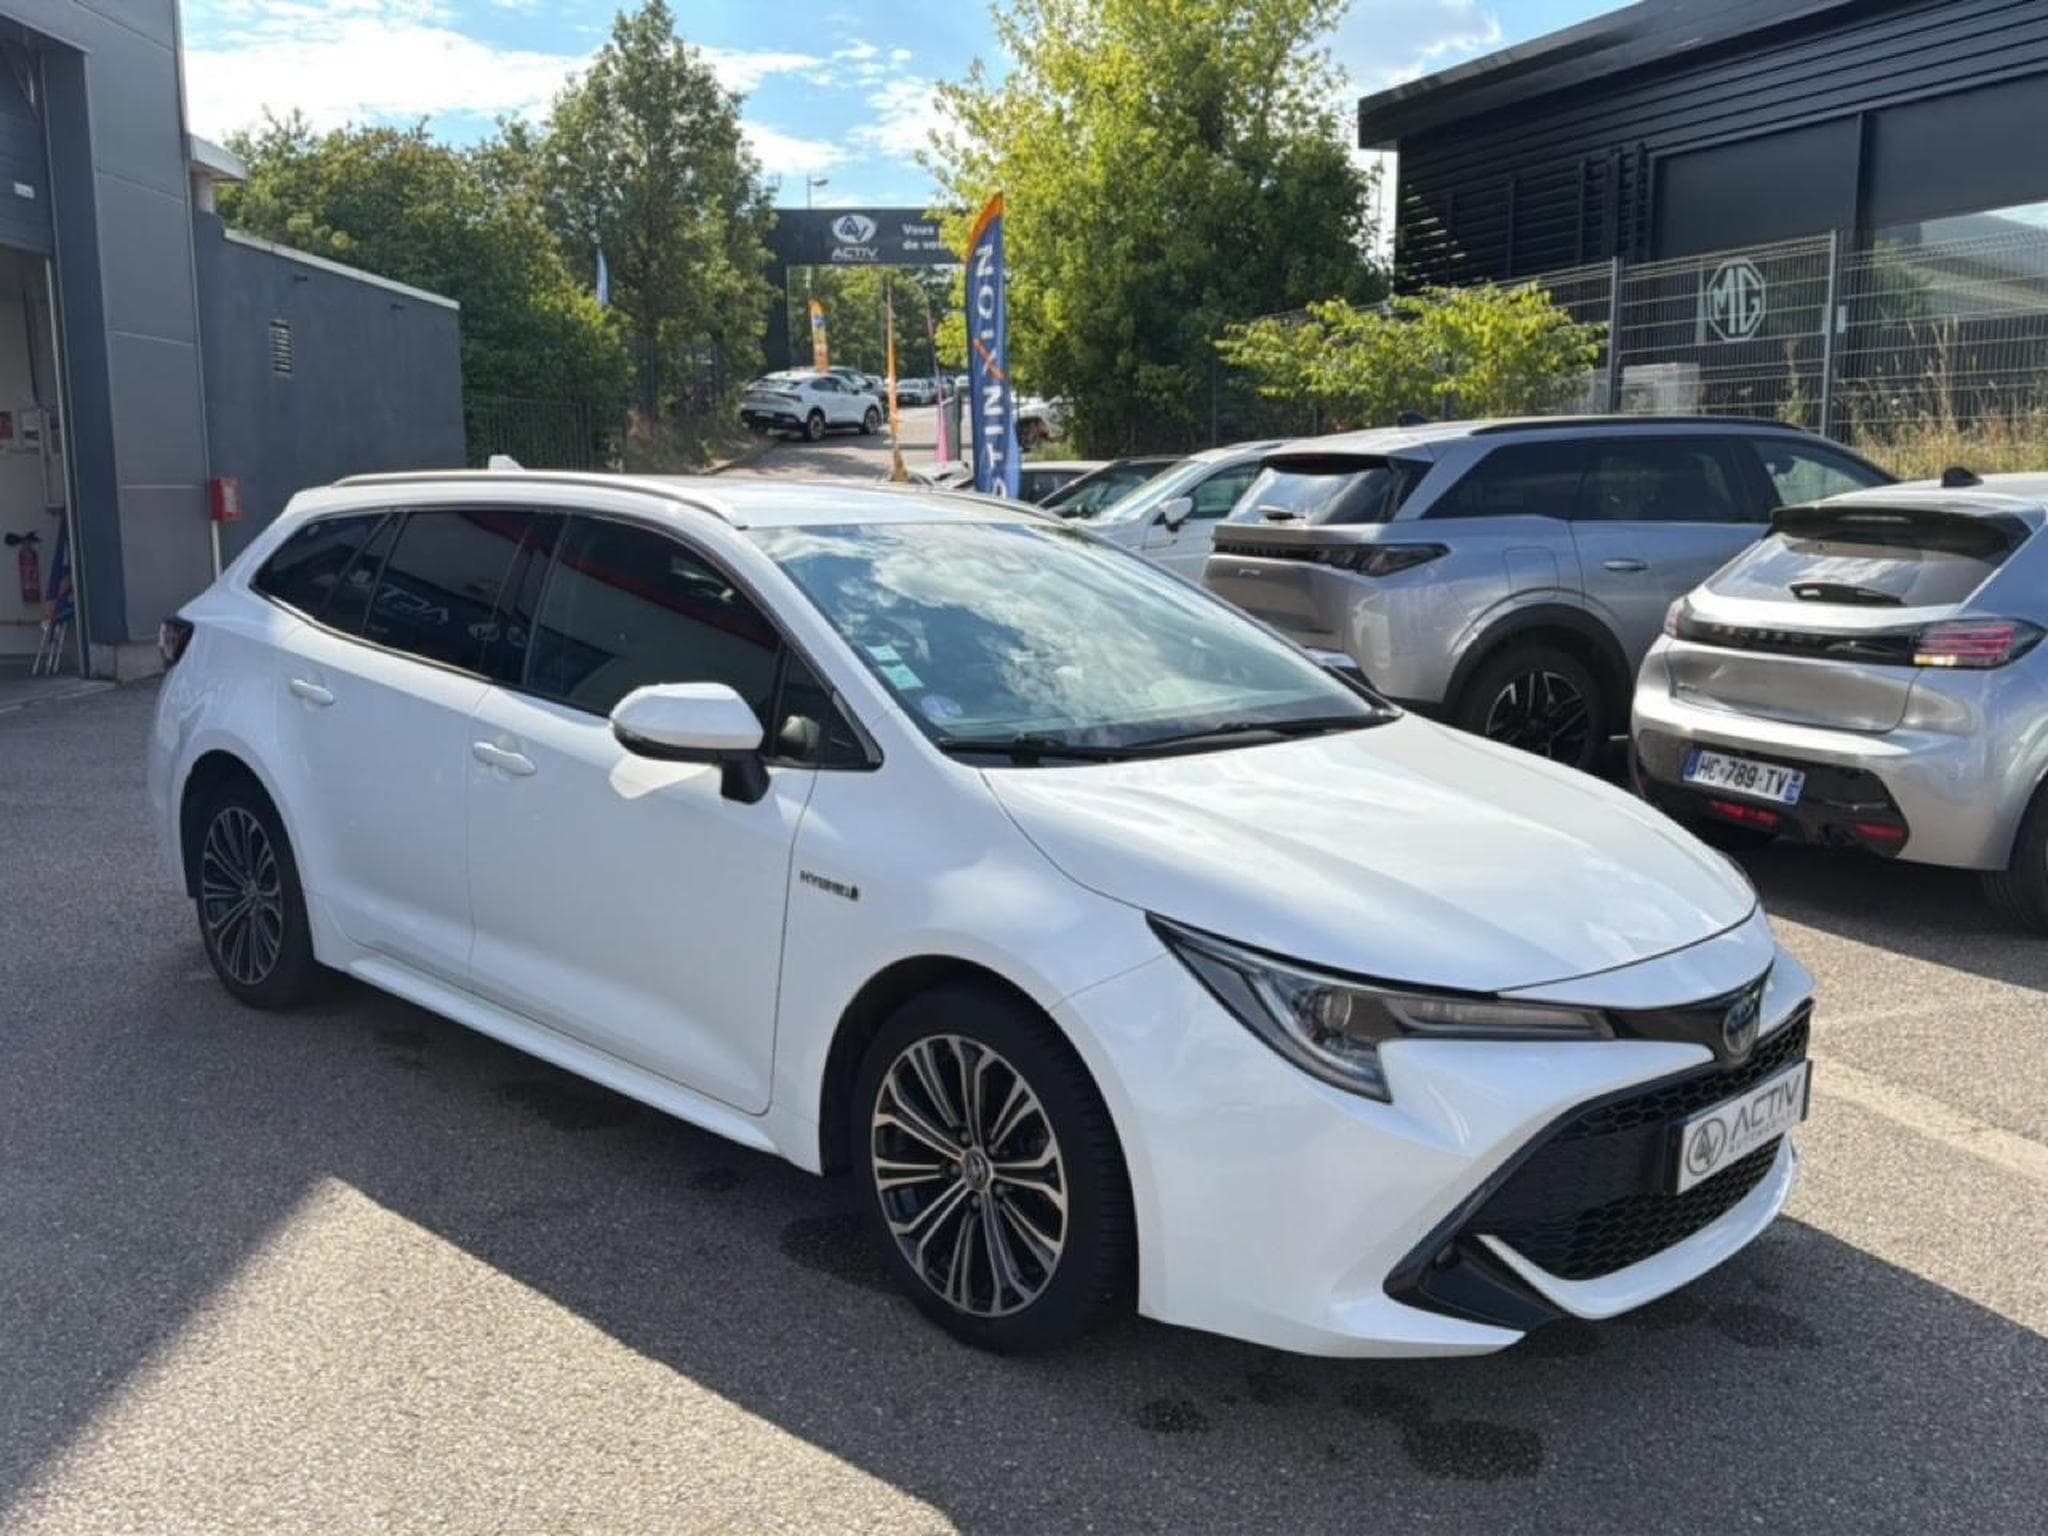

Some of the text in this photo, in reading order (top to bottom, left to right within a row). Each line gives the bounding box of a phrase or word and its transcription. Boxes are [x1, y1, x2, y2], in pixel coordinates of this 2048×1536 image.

[832, 246, 879, 258] ACTIV
[1712, 264, 1762, 335] MG
[1731, 1073, 1802, 1141] ACTIV
